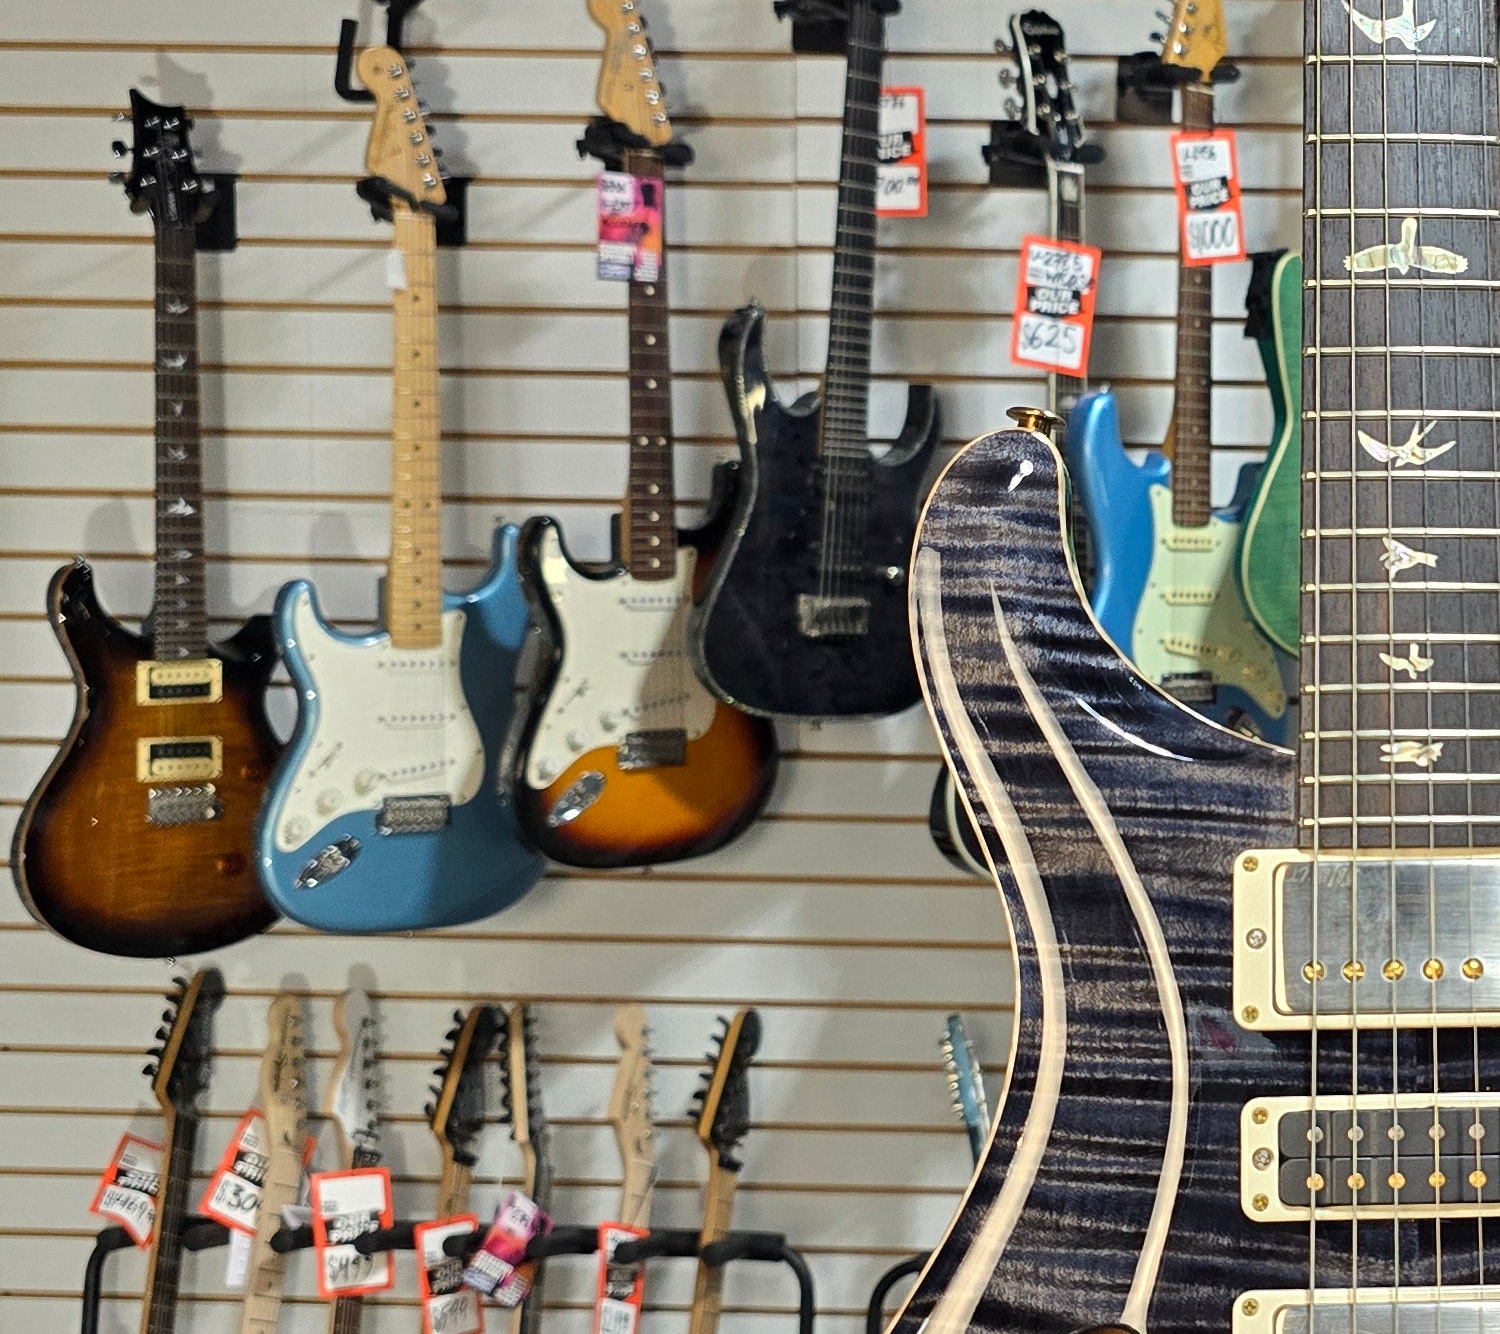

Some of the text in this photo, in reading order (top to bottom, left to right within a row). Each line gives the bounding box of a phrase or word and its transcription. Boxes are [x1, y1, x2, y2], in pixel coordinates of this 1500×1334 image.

[1036, 287, 1073, 302] OUR
[1029, 298, 1081, 315] PRICE
[1022, 322, 1078, 355] $625
